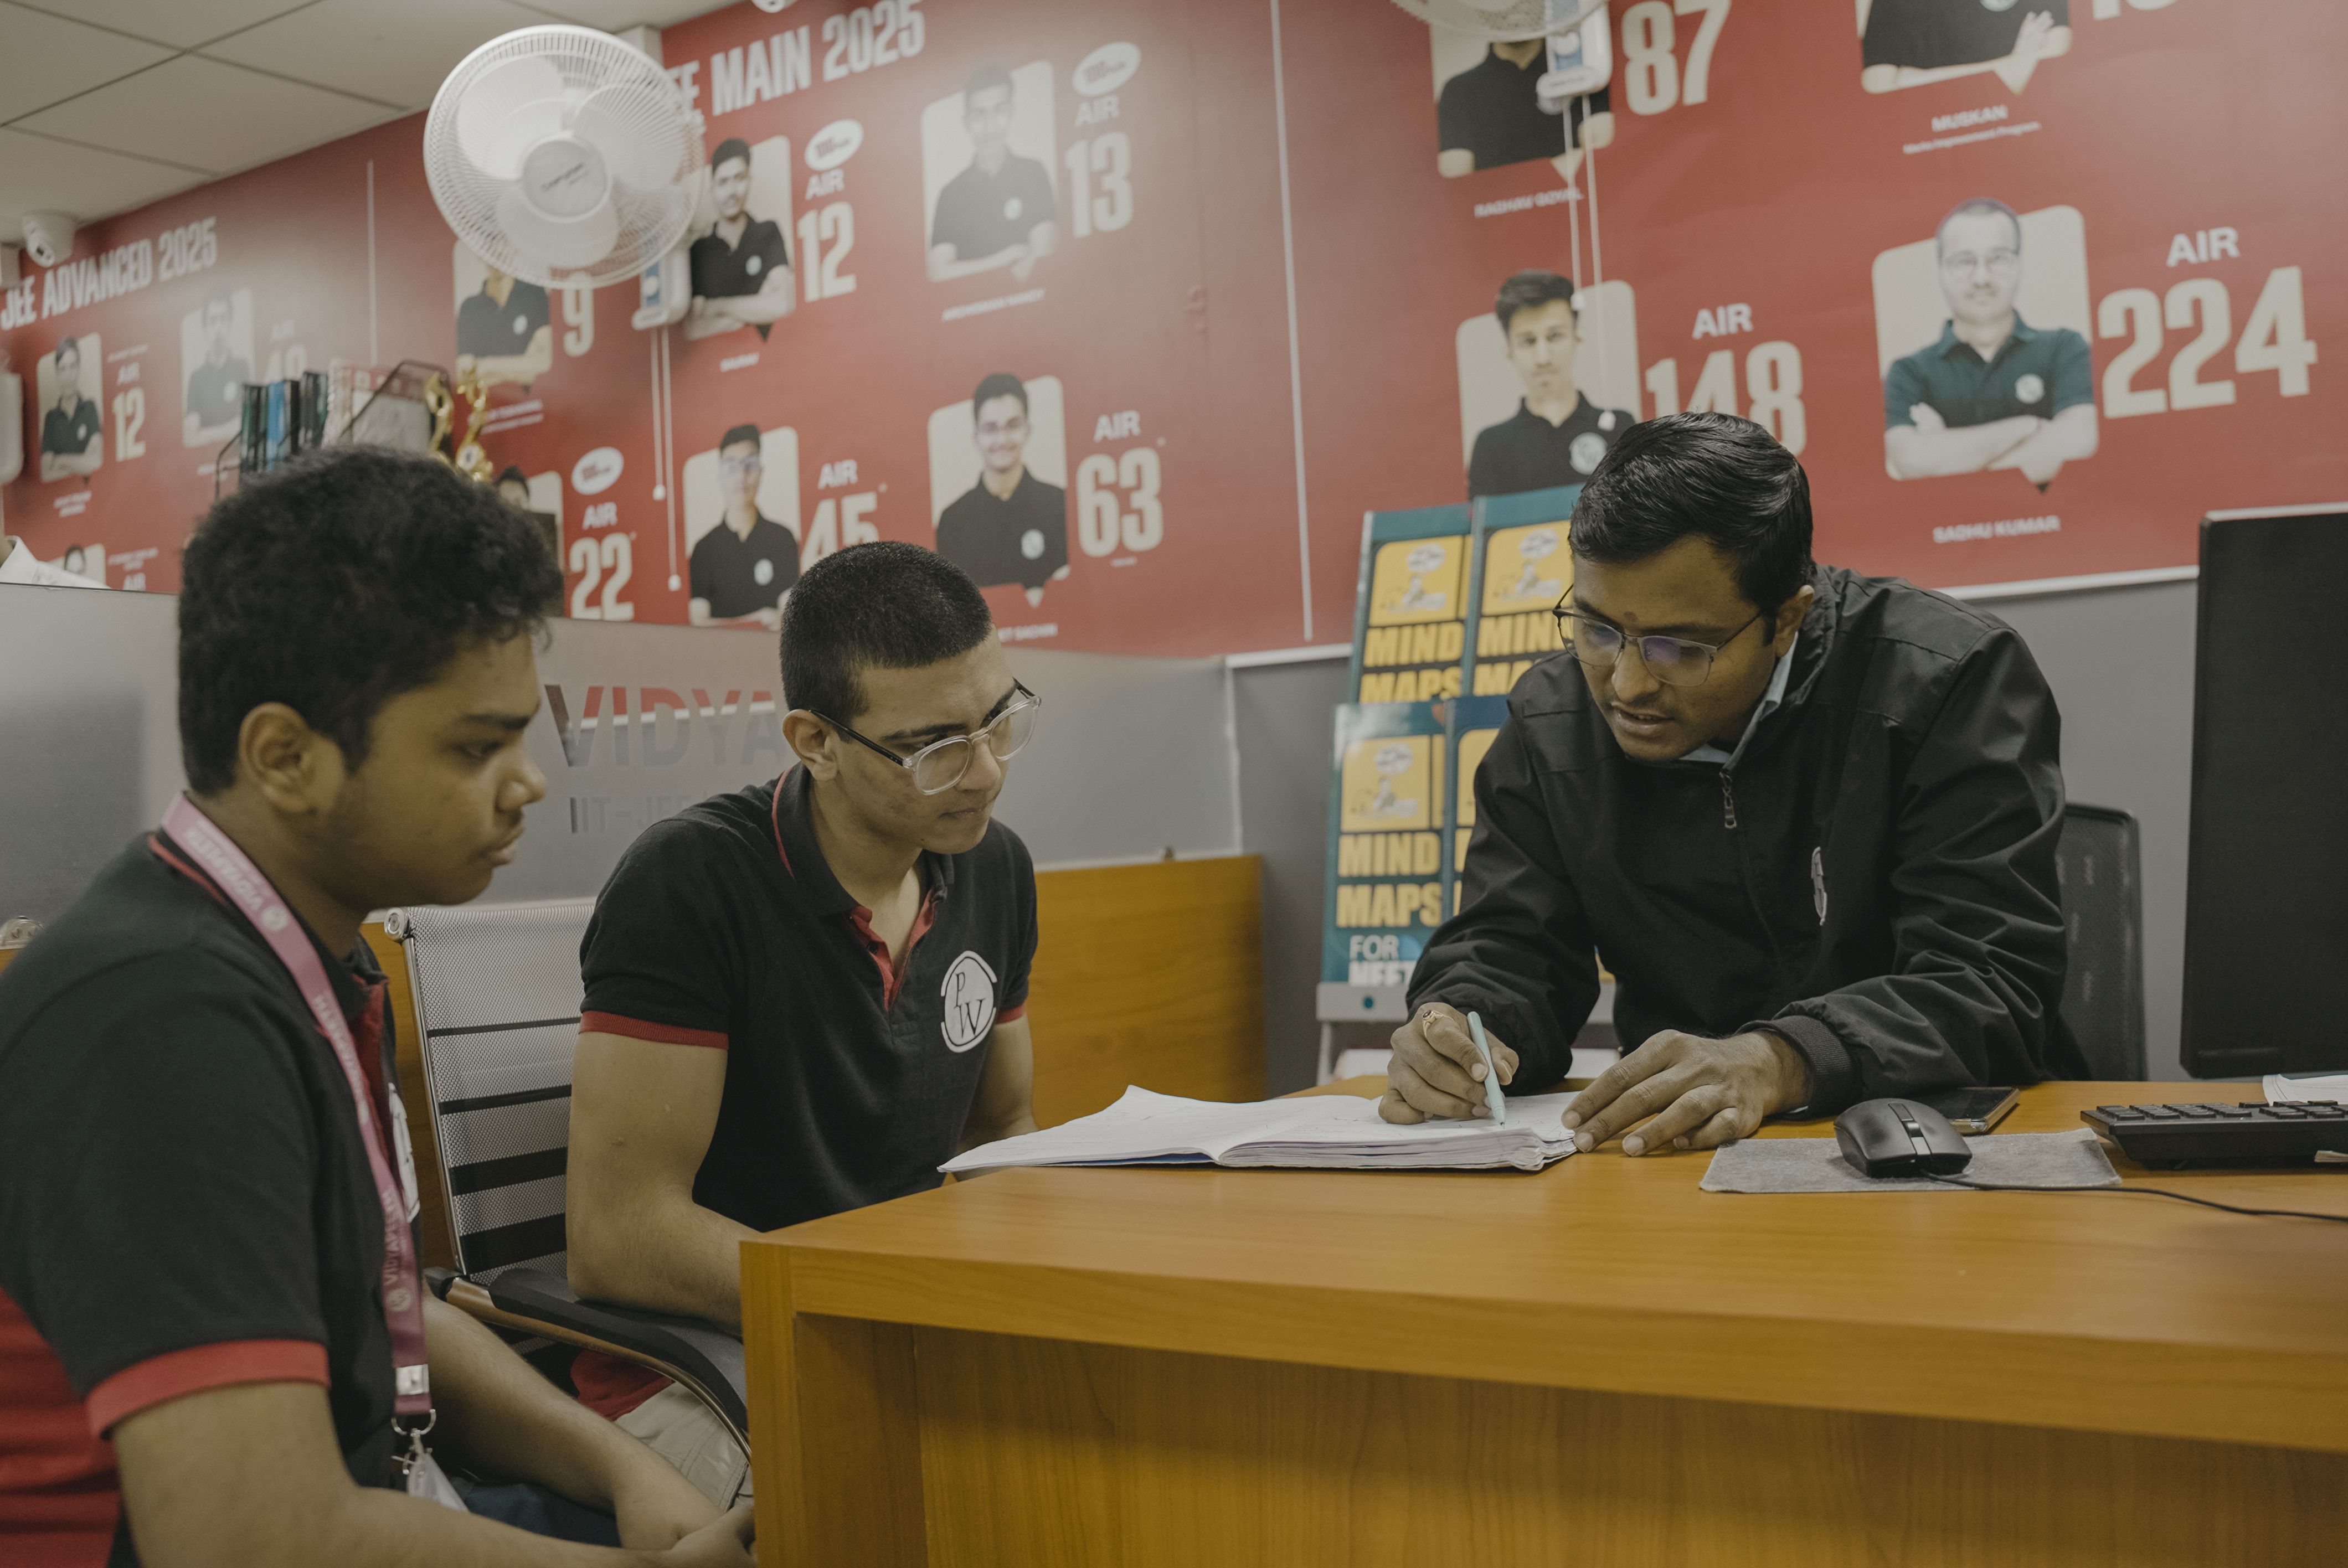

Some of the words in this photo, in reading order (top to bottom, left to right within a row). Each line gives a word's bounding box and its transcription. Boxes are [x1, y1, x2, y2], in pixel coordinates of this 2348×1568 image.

[711, 25, 812, 117] MAIN
[822, 0, 925, 82] 2025
[1621, 0, 1732, 115] 87
[1074, 95, 1121, 128] AIR
[1931, 104, 2009, 132] MUSKAN
[805, 168, 846, 201] AIR
[1064, 132, 1134, 239] 13
[1474, 195, 1535, 218] RAGHAV
[797, 201, 857, 303] 12
[2166, 226, 2241, 268] AIR
[0, 275, 37, 331] JEE
[42, 239, 153, 320] ADVANCED
[158, 216, 219, 283] 2025
[562, 271, 595, 358] 9
[1692, 302, 1754, 339] AIR
[2097, 265, 2319, 419] 224
[1645, 340, 1807, 456] 148
[112, 386, 146, 462] 12
[1093, 410, 1141, 443] AIR
[817, 458, 859, 491] AIR
[582, 501, 619, 531] AIR
[1076, 447, 1164, 558] 63
[1994, 514, 2061, 537] KUMAR
[800, 491, 879, 577] 45
[569, 533, 635, 621] 22
[1363, 621, 1465, 667] MIND
[1360, 666, 1463, 704] MAPS
[1337, 832, 1440, 878] MIND
[1336, 882, 1442, 928] MAPS
[1349, 934, 1400, 961] FOR
